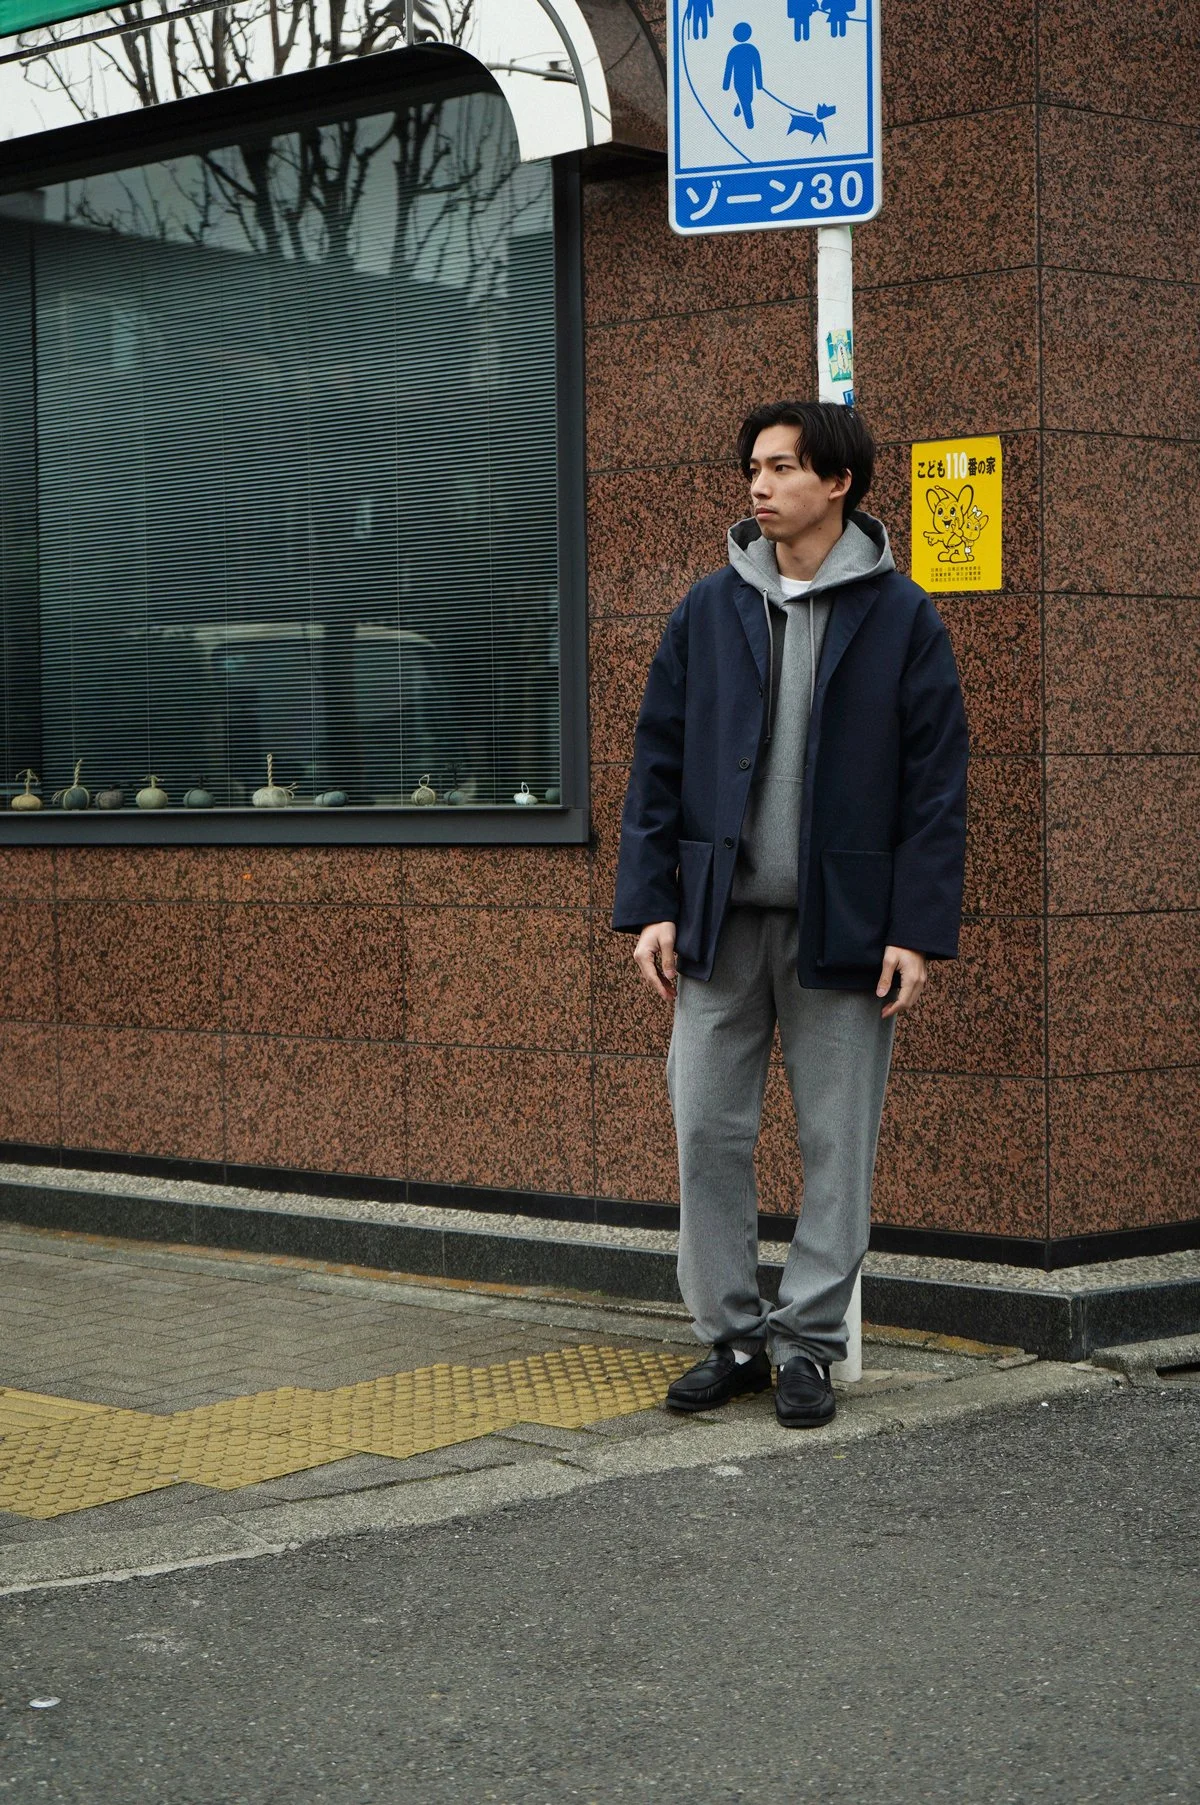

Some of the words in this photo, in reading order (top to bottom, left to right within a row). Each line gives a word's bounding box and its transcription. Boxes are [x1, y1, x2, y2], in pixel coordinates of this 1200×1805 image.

[686, 170, 863, 221] ゾーン30
[917, 451, 996, 480] こども110番の家
